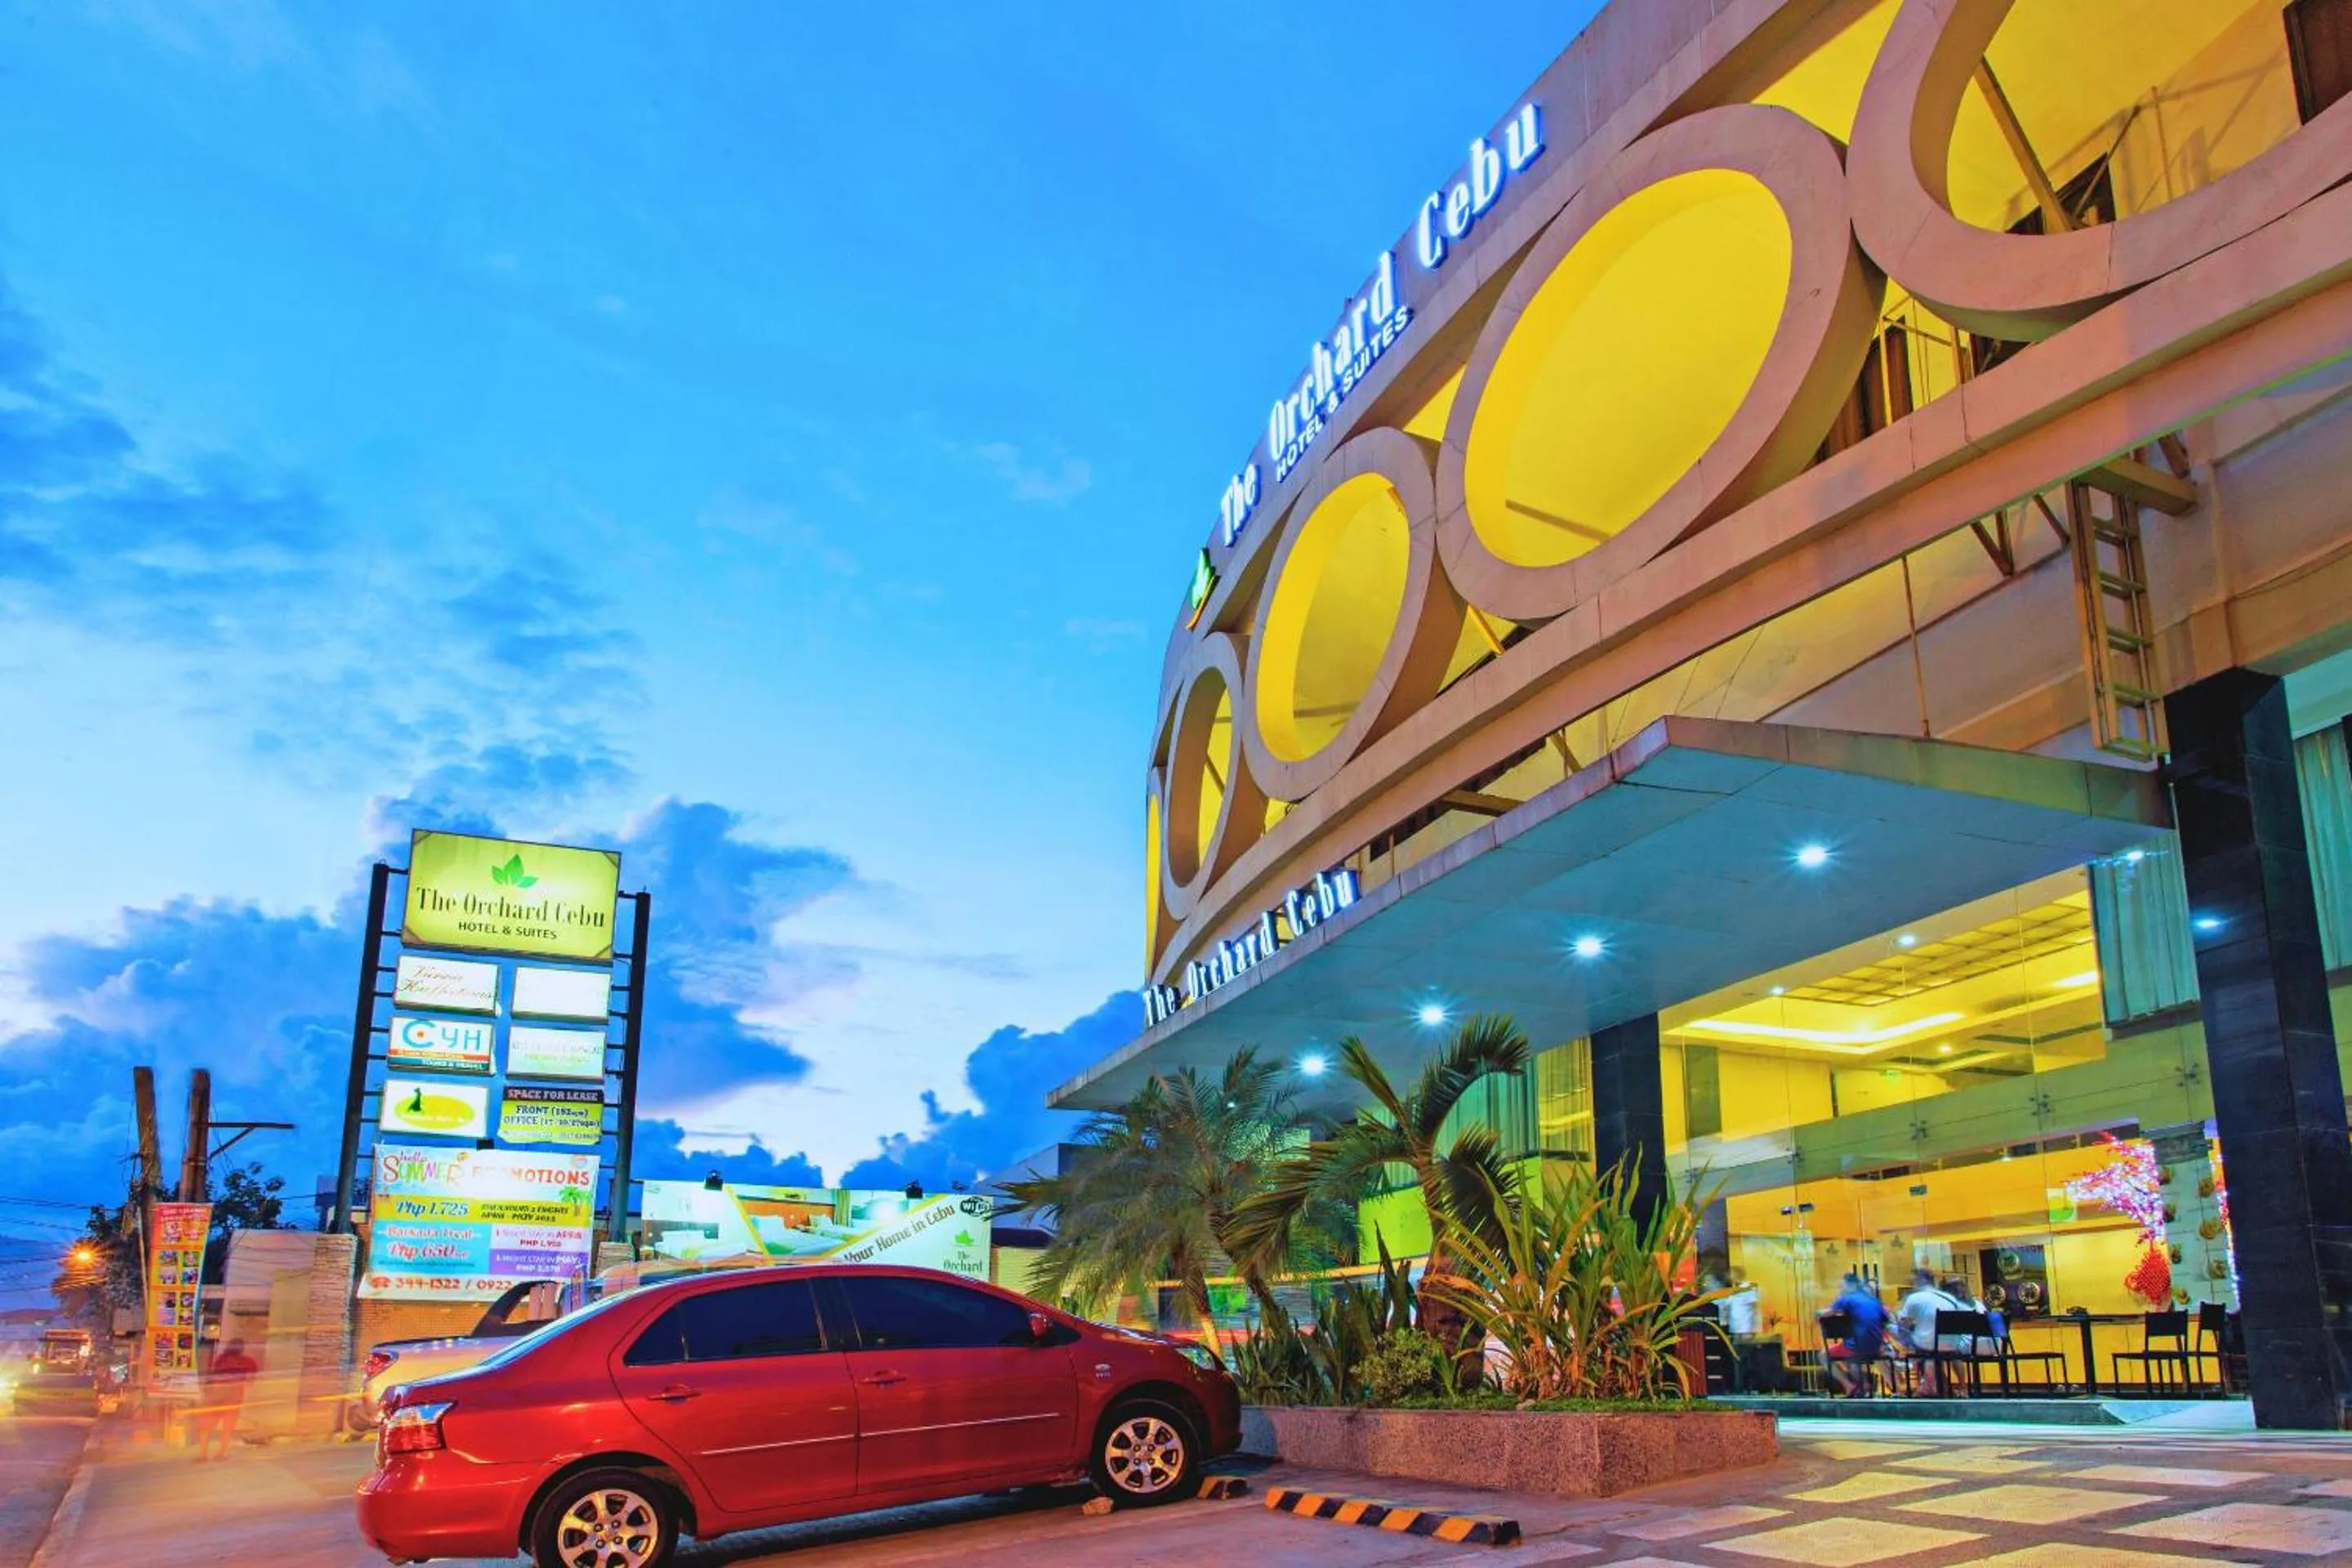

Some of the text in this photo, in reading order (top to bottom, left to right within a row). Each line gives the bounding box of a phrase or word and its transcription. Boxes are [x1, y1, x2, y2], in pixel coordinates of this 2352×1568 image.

[1222, 102, 1543, 544] The Orchard Cebu
[1276, 305, 1413, 482] HOTEL & SUITES
[416, 886, 605, 928] The Orchard Cebu
[458, 920, 558, 940] HOTEL & SUITES
[1143, 870, 1355, 1027] The Orchard Cebu
[507, 1089, 599, 1102] SPACE FOR LEASE
[515, 1104, 549, 1114] FRONT
[503, 1115, 538, 1125] OFFICE
[472, 1165, 590, 1186] PMOTIONS
[396, 1200, 426, 1217] Php
[876, 1228, 912, 1252] Home
[911, 1219, 927, 1233] in
[925, 1205, 956, 1225] Cebu
[942, 1259, 983, 1273] Orchard
